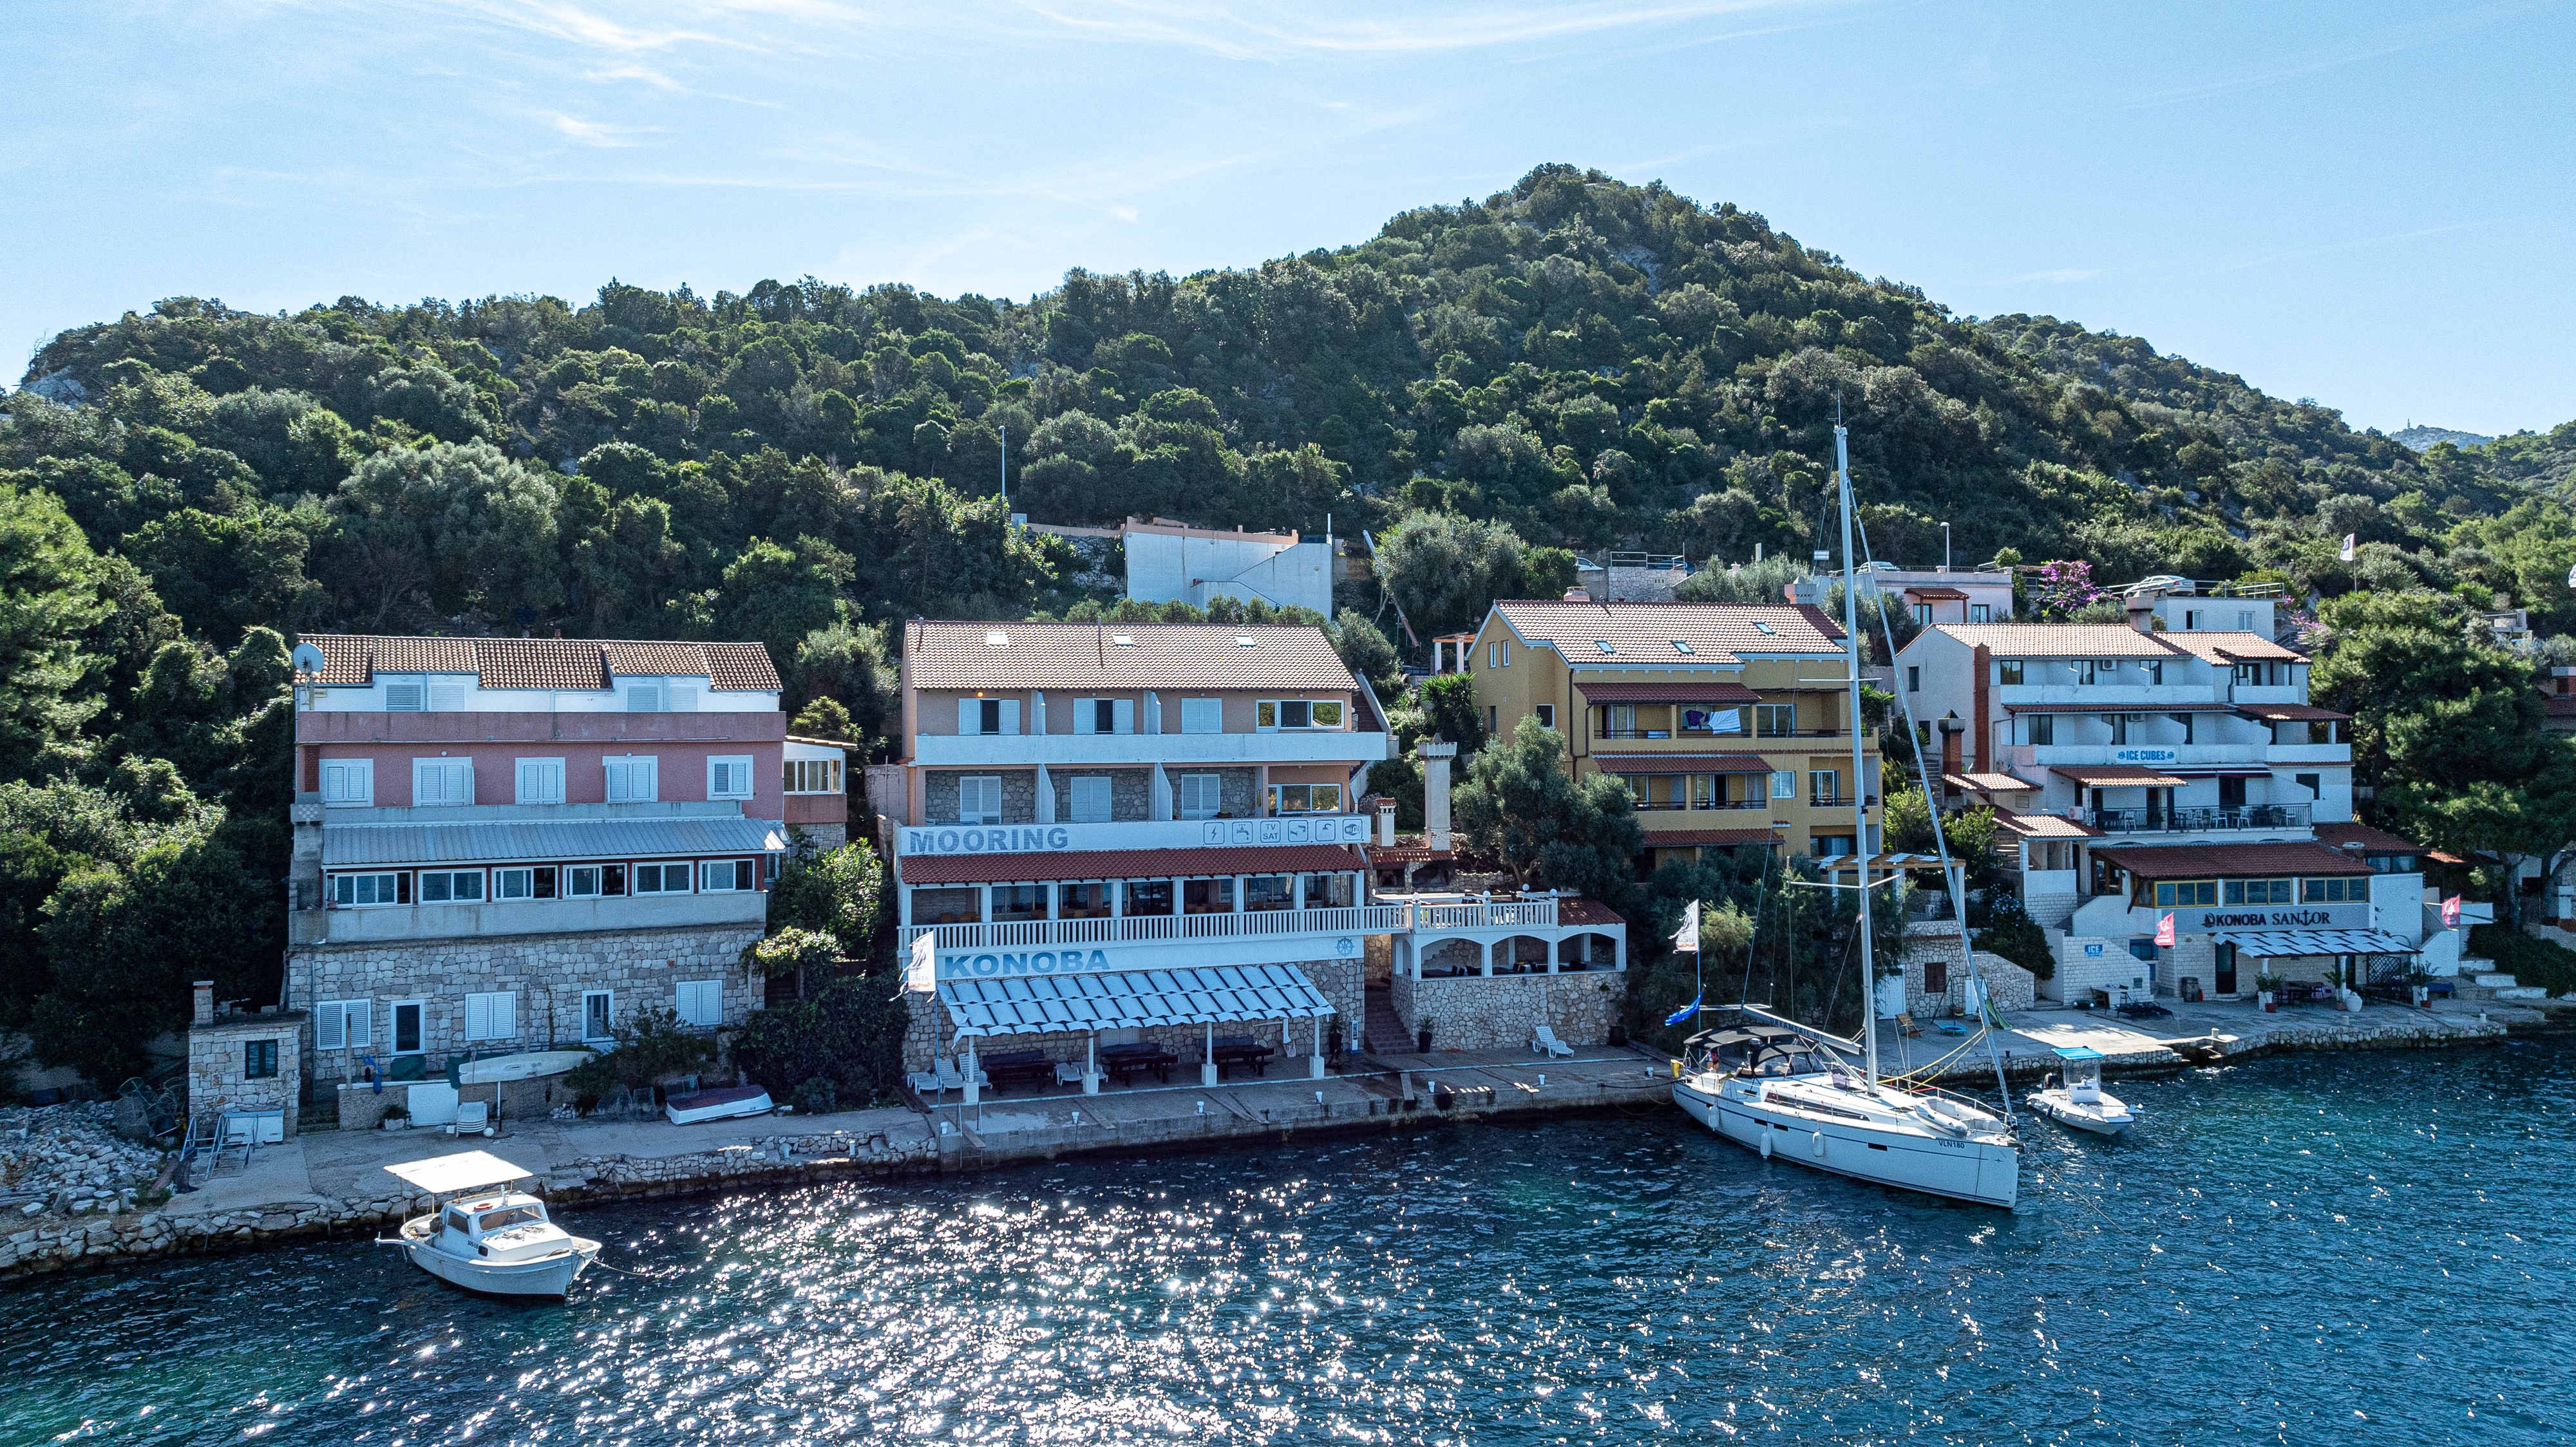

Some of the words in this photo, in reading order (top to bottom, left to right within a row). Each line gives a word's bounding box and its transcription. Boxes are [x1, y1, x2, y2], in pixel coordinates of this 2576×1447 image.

[2126, 751, 2139, 760] ICE
[2141, 750, 2165, 760] CUBES
[910, 828, 1068, 853] MOORING
[2217, 914, 2266, 926] KONOBA
[944, 950, 1110, 978] KONOBA
[1770, 1017, 1824, 1041] DREAMSAIL.ME
[1938, 1140, 1965, 1149] VLN180
